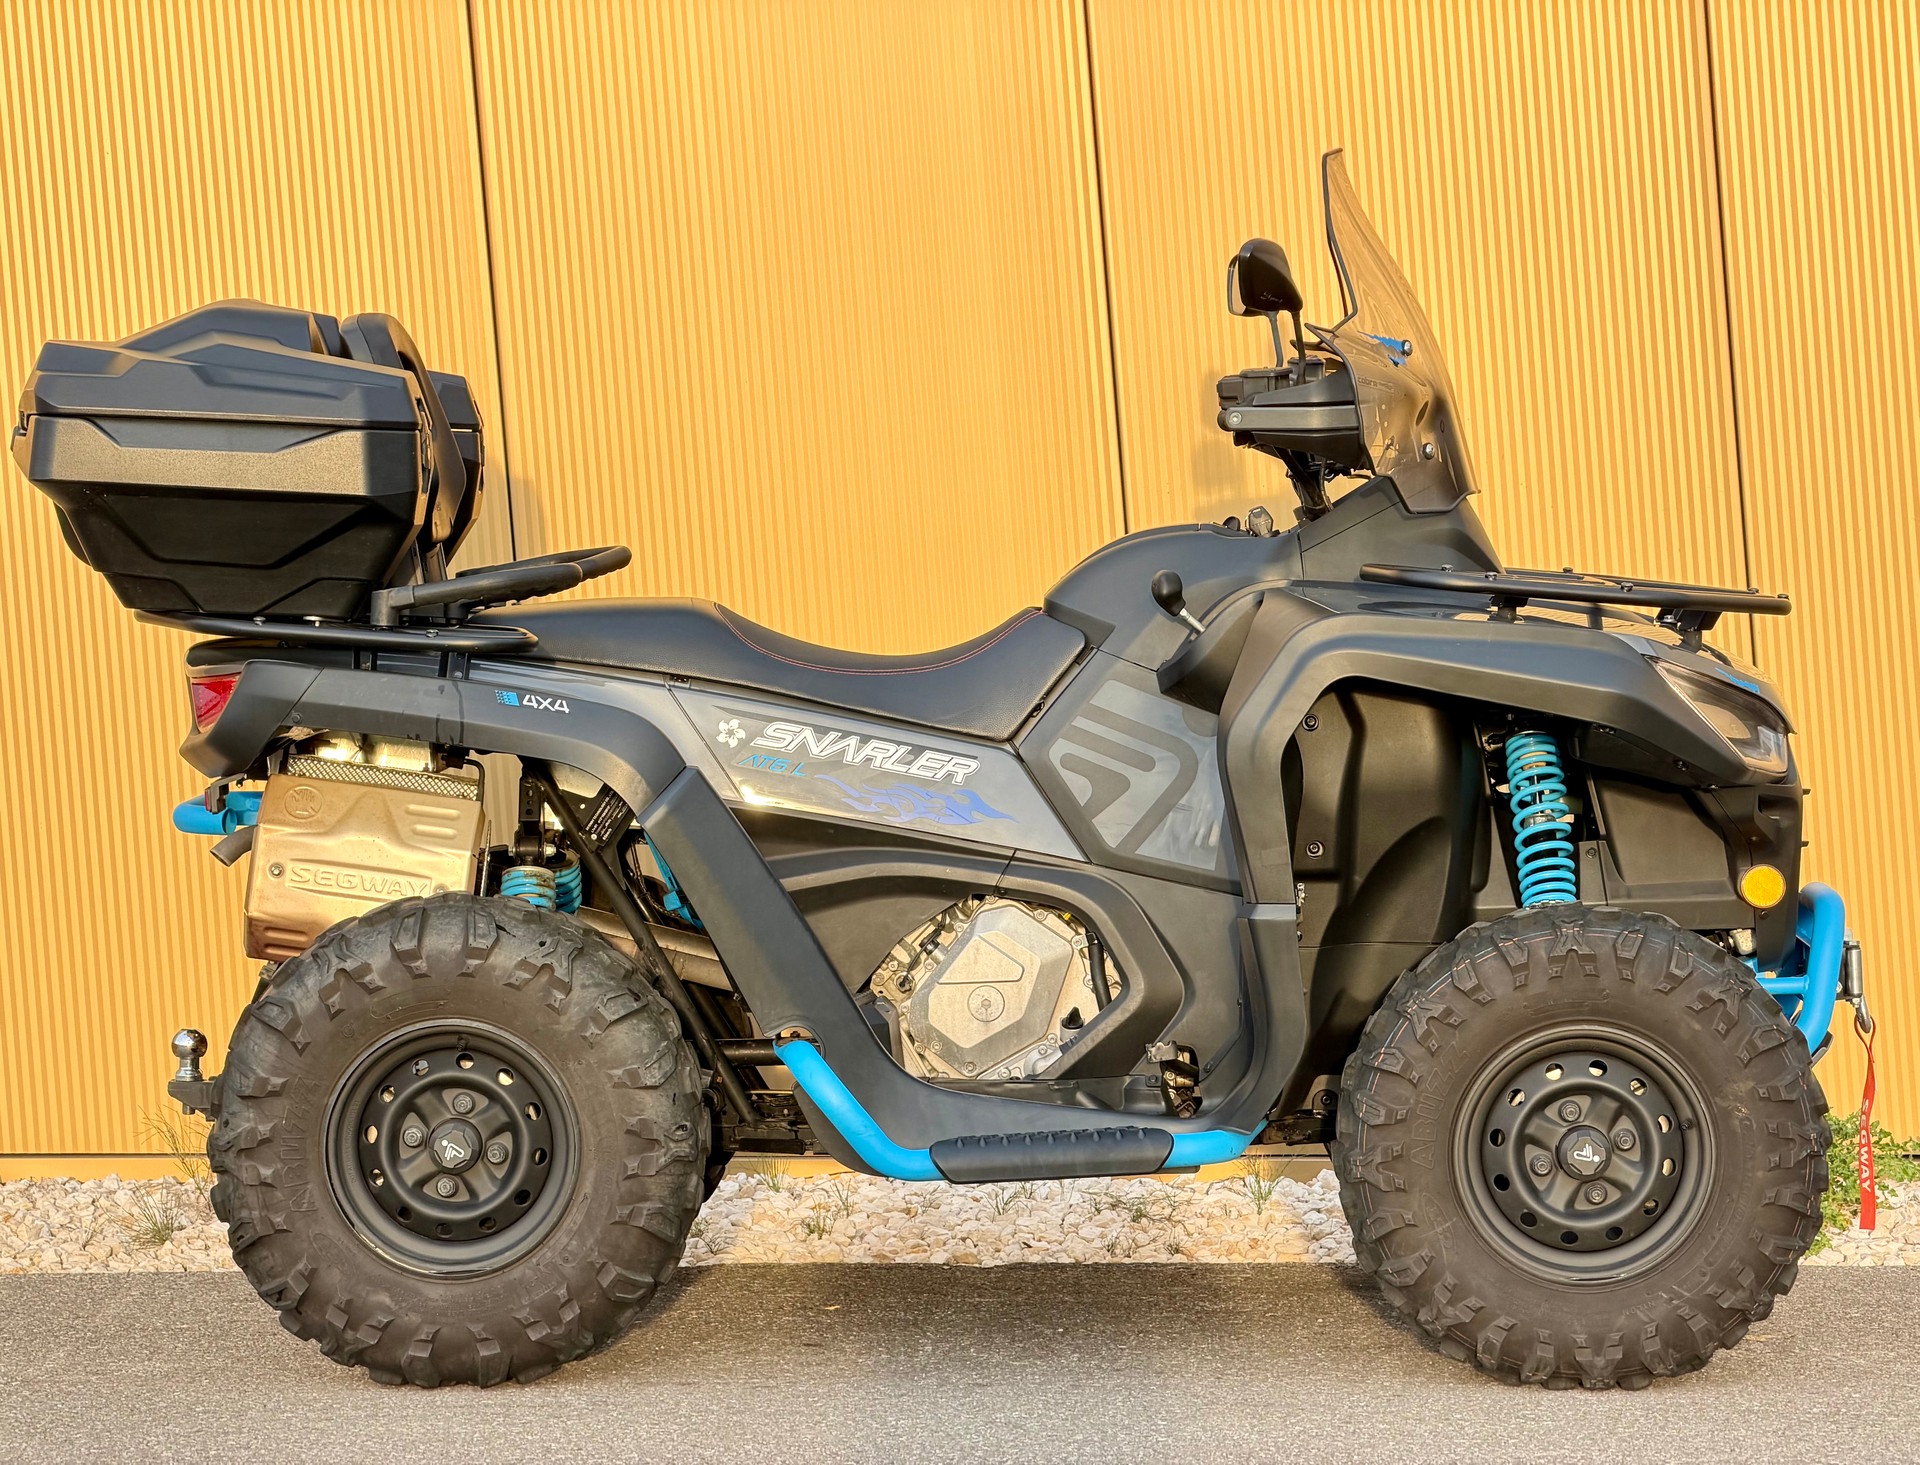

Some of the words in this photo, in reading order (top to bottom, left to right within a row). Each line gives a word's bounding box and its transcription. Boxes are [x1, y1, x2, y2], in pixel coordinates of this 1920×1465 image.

[739, 754, 791, 773] AT6
[750, 721, 981, 786] SNARLER
[290, 866, 428, 896] SEGWAY
[1860, 1098, 1872, 1193] SEGWAY
